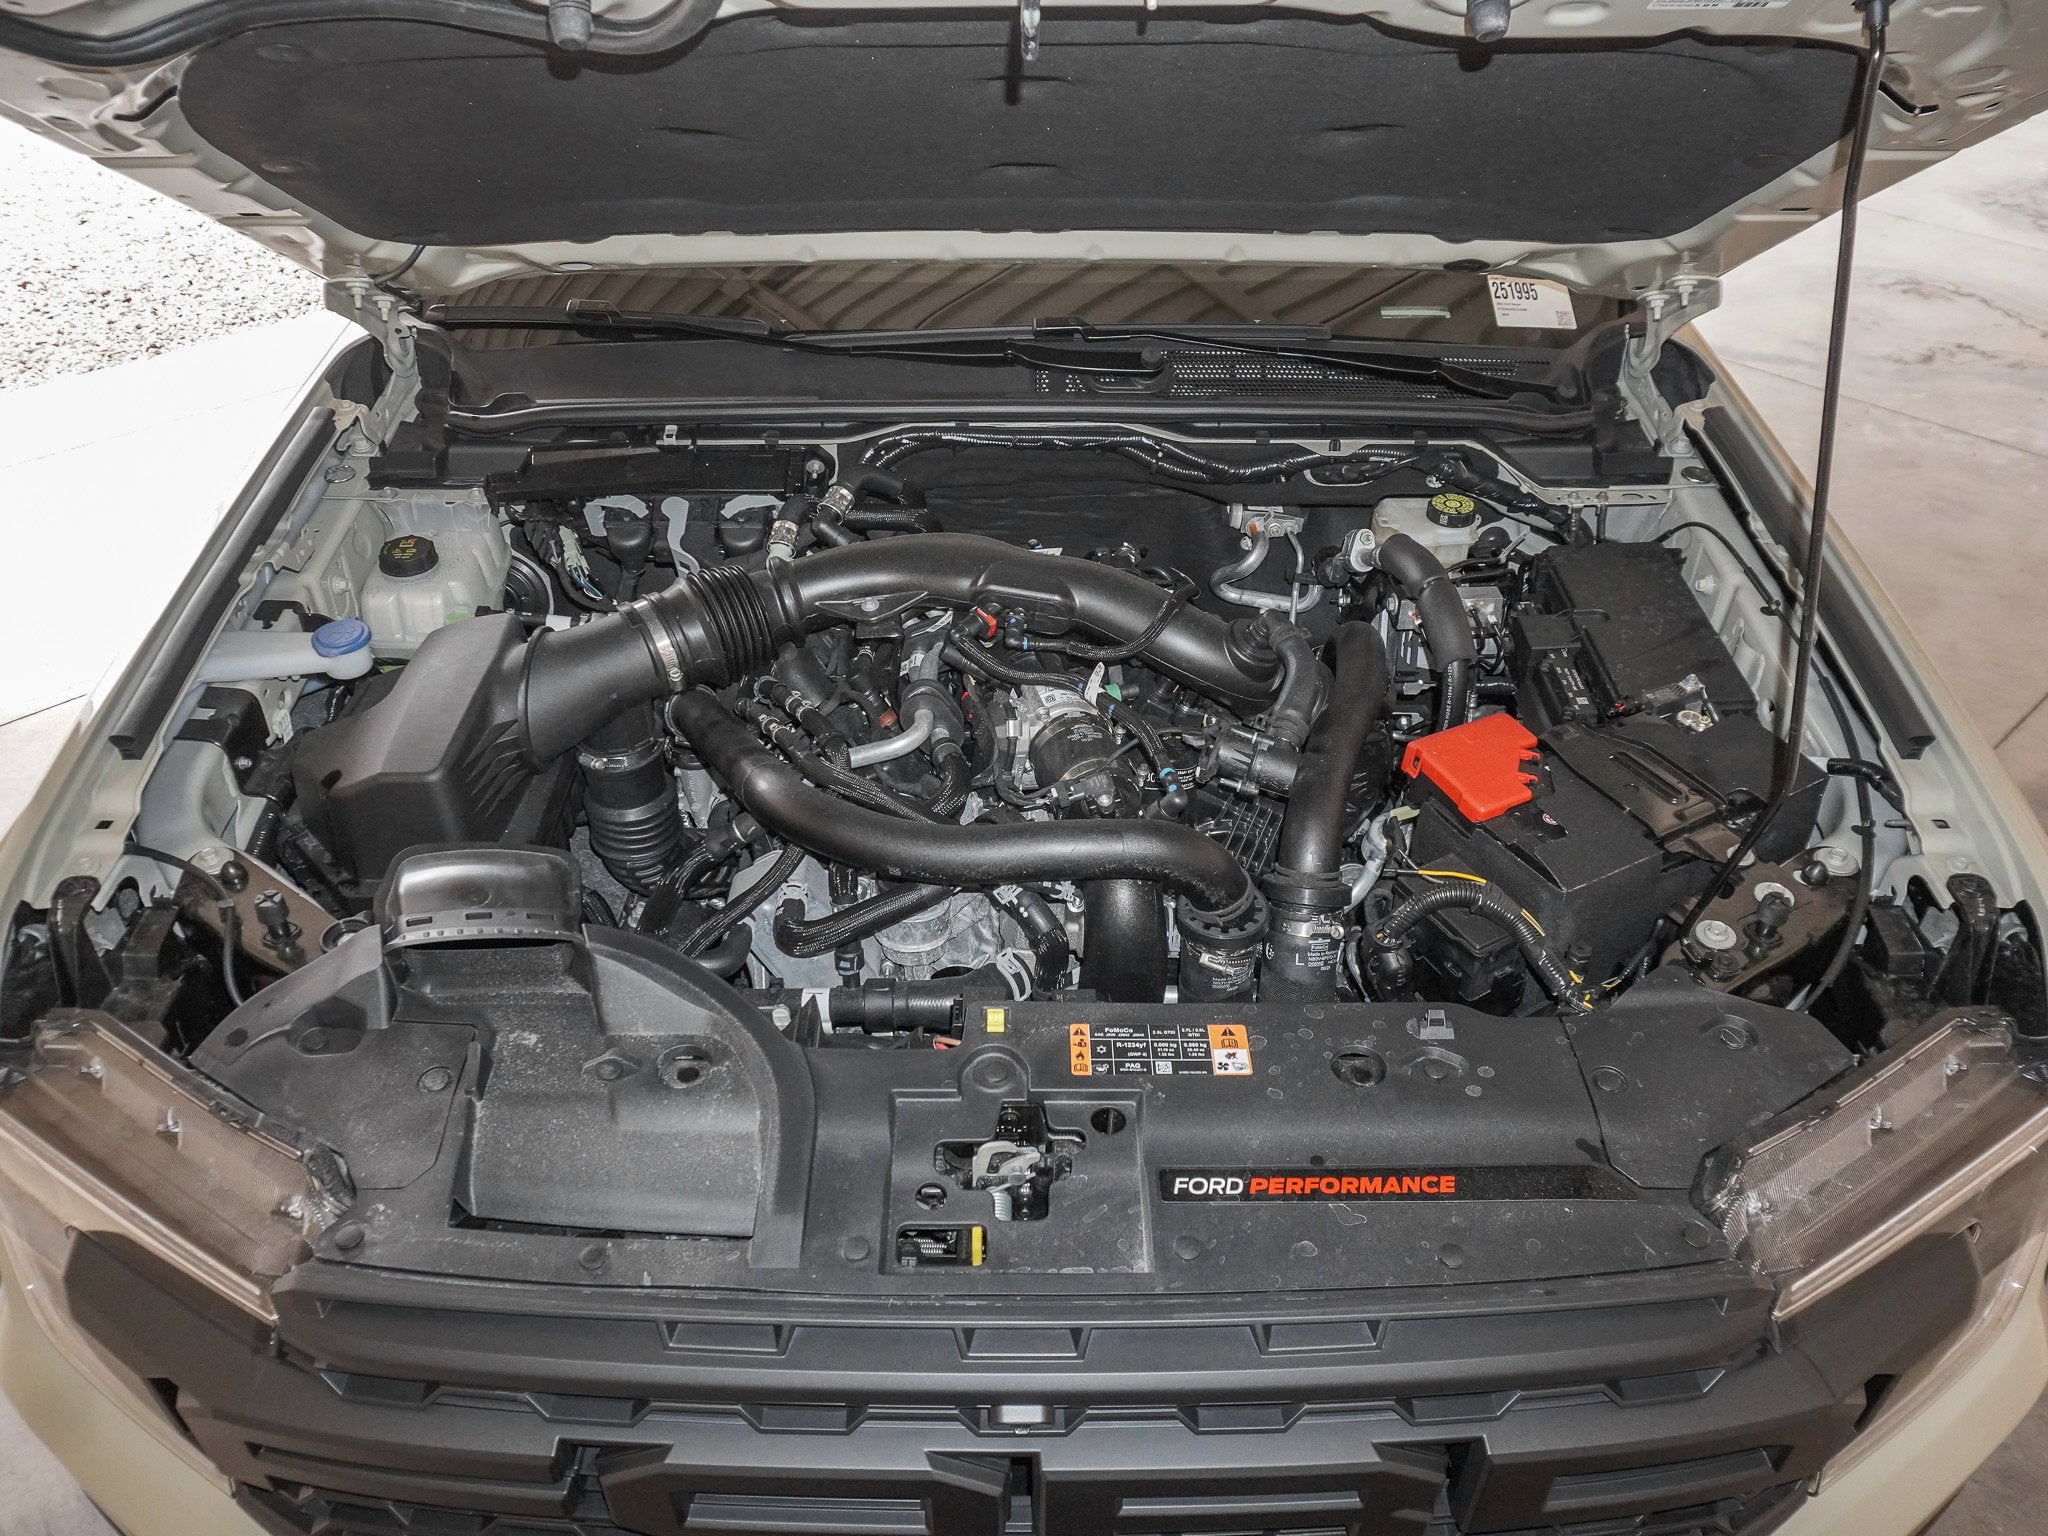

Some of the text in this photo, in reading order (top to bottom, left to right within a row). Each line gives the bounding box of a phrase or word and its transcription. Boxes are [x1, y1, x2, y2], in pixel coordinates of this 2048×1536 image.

[1492, 281, 1538, 300] 251995
[1295, 953, 1305, 965] L
[1173, 1175, 1456, 1195] FORD PERFORMANCE
